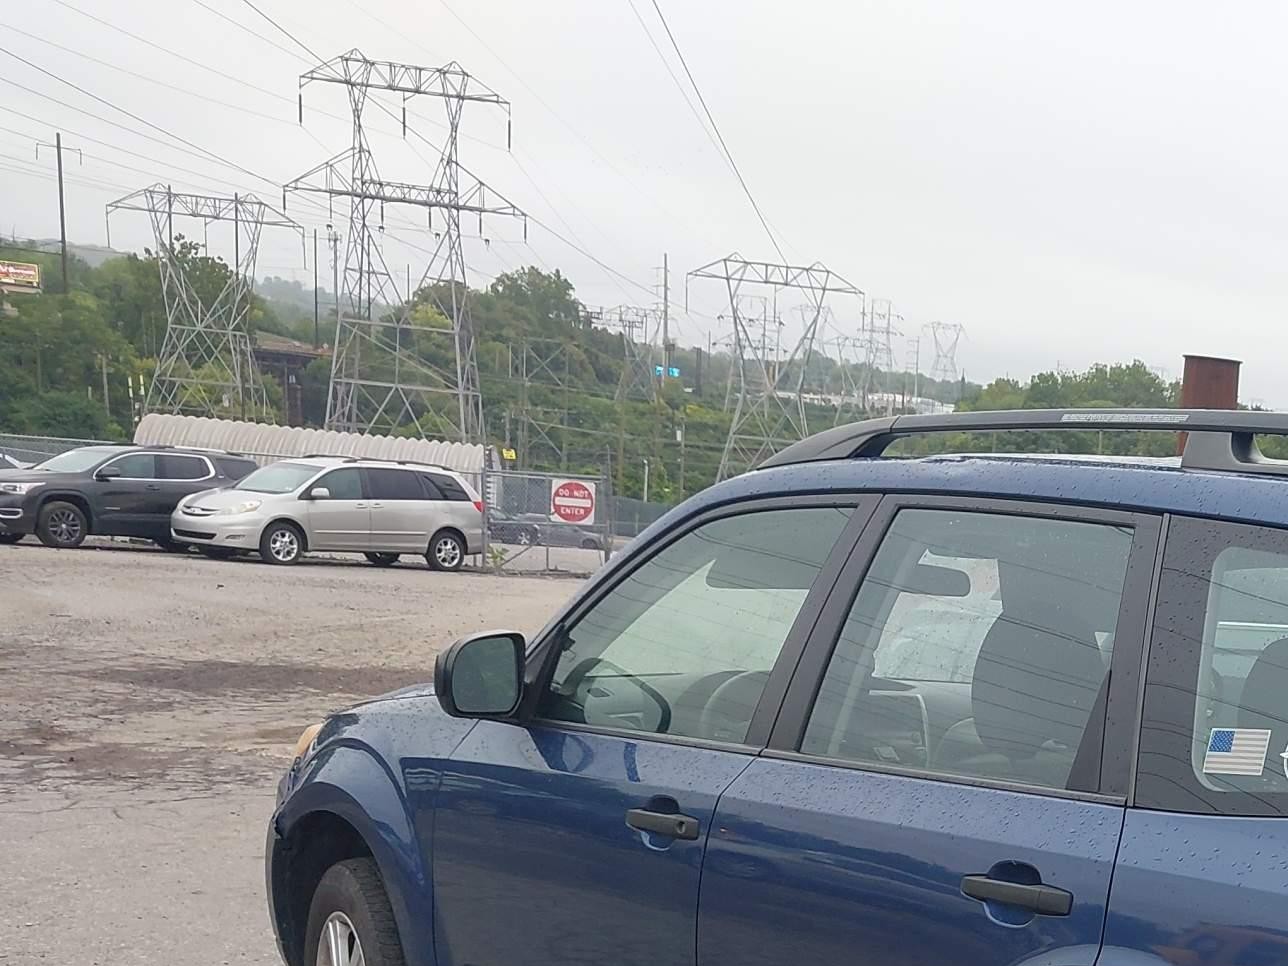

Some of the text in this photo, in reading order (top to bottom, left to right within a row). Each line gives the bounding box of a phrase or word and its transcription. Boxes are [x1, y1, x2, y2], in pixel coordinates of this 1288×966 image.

[558, 488, 588, 498] DO NOT
[560, 506, 585, 515] ENTER
